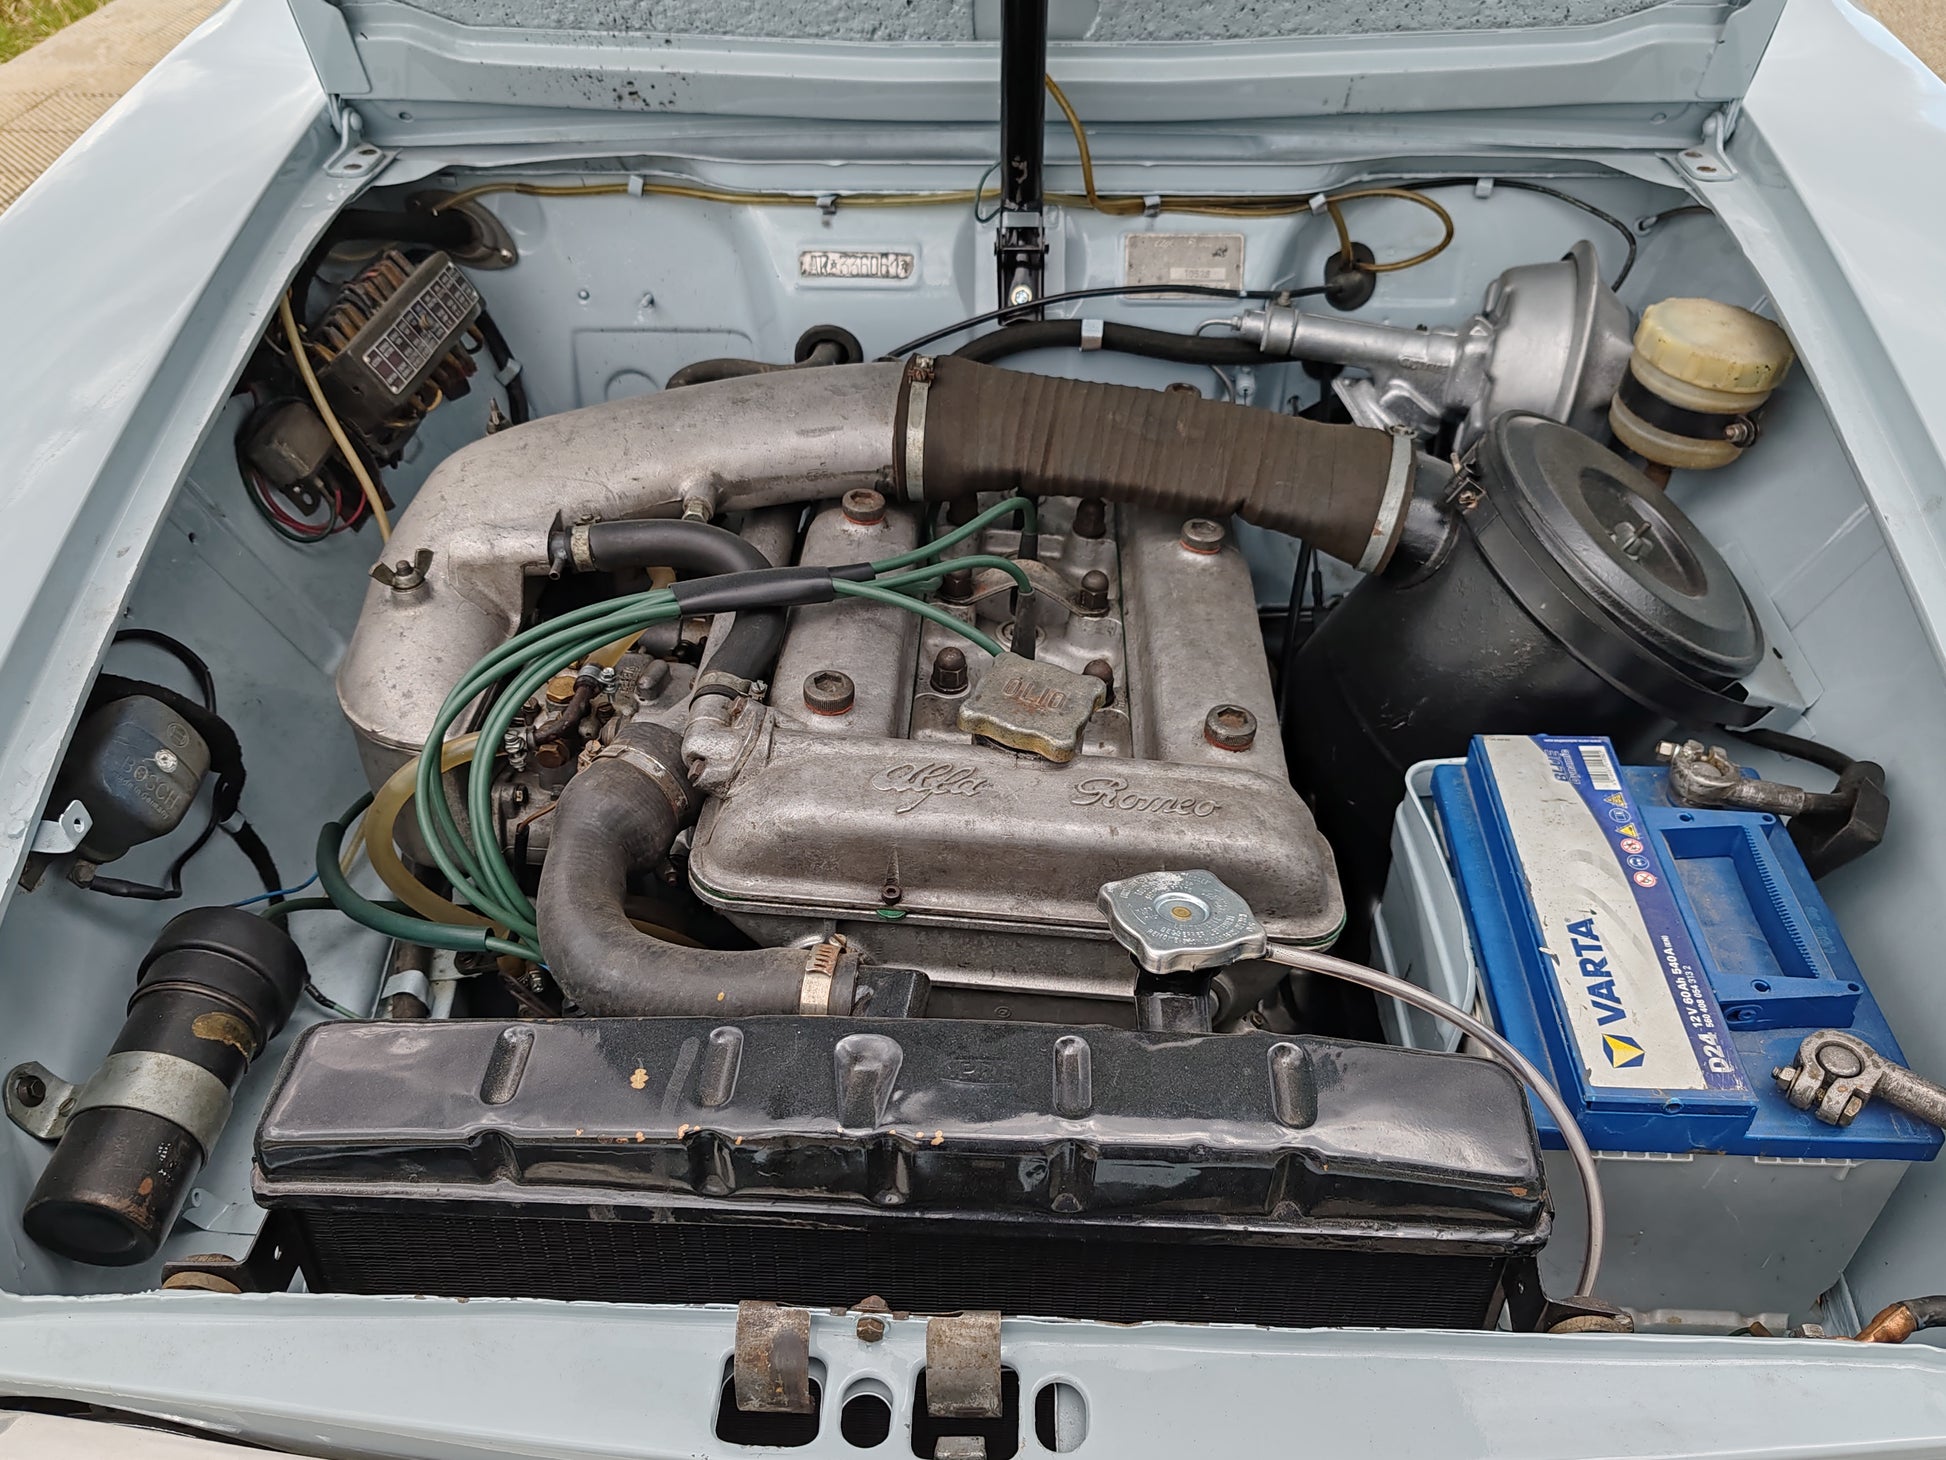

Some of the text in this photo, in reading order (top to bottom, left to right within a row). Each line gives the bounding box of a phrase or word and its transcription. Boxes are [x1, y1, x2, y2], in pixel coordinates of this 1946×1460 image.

[1001, 678, 1068, 710] OLIO
[1543, 749, 1569, 781] BLUE
[120, 756, 180, 810] BOSCH
[871, 763, 1221, 818] Alfa Romeo
[1566, 918, 1627, 1026] VARTA
[1675, 977, 1694, 1005] 60Ah
[1690, 984, 1703, 998] 054
[1696, 999, 1708, 1013] 408
[1686, 1007, 1703, 1028] 12V
[1702, 1013, 1715, 1028] 560
[1698, 1032, 1735, 1073] D24
